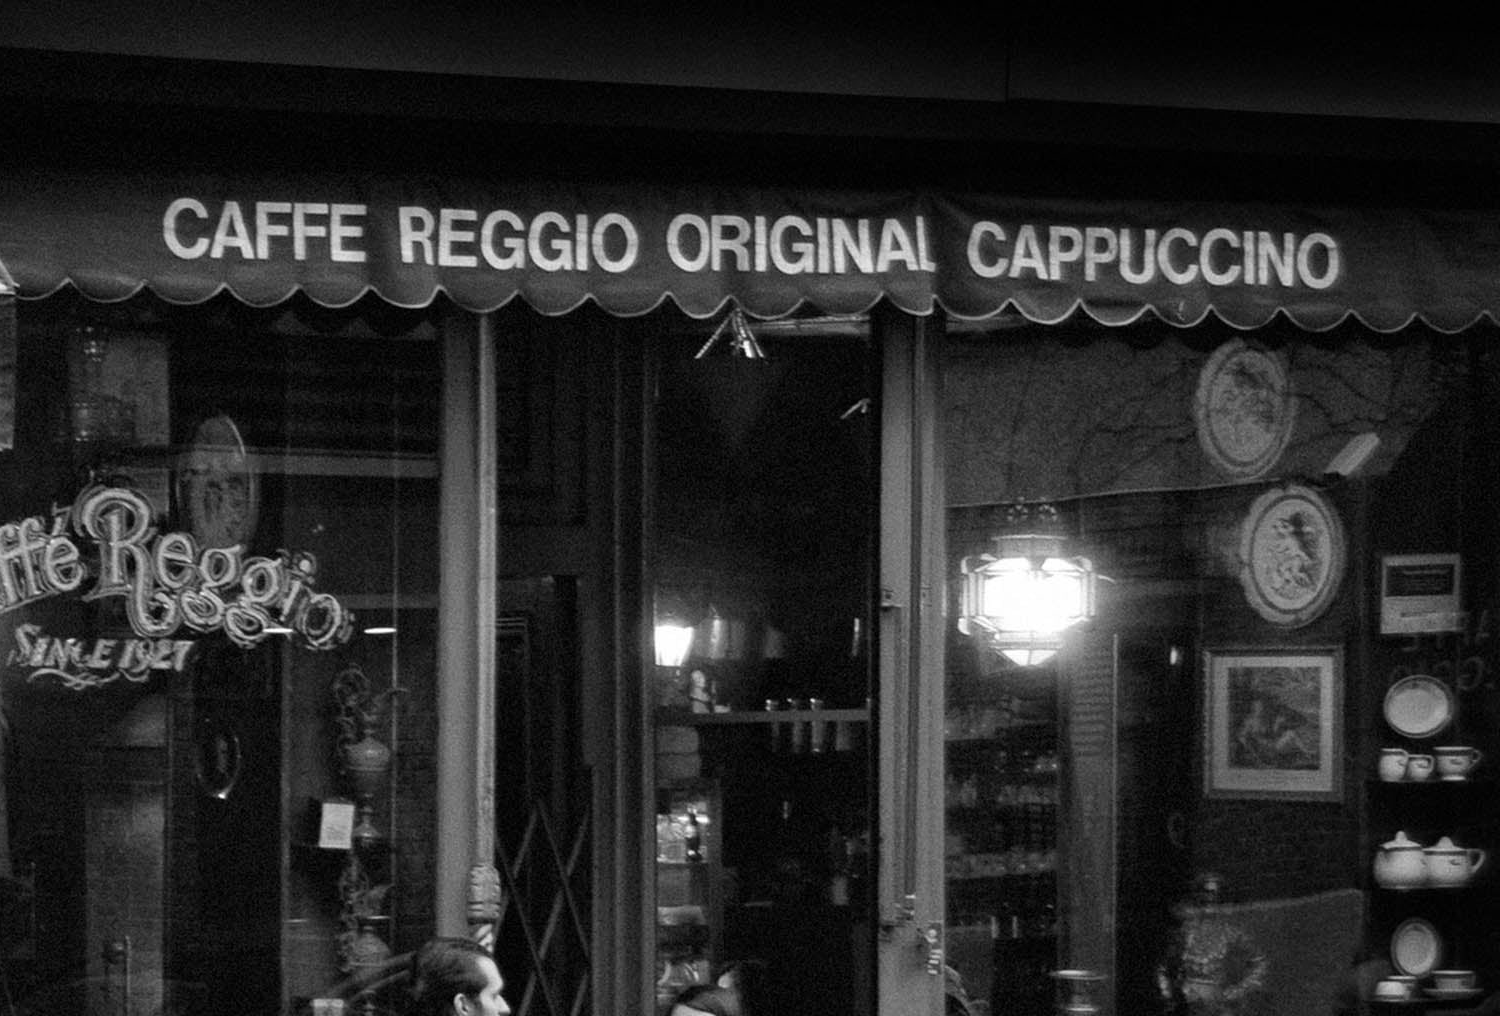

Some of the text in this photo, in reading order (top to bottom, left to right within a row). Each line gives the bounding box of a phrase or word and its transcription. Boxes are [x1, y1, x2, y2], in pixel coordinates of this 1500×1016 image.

[162, 197, 1340, 290] CAFFE REGGIO ORIGINAL CAPPUCCINO
[117, 638, 196, 674] 1927
